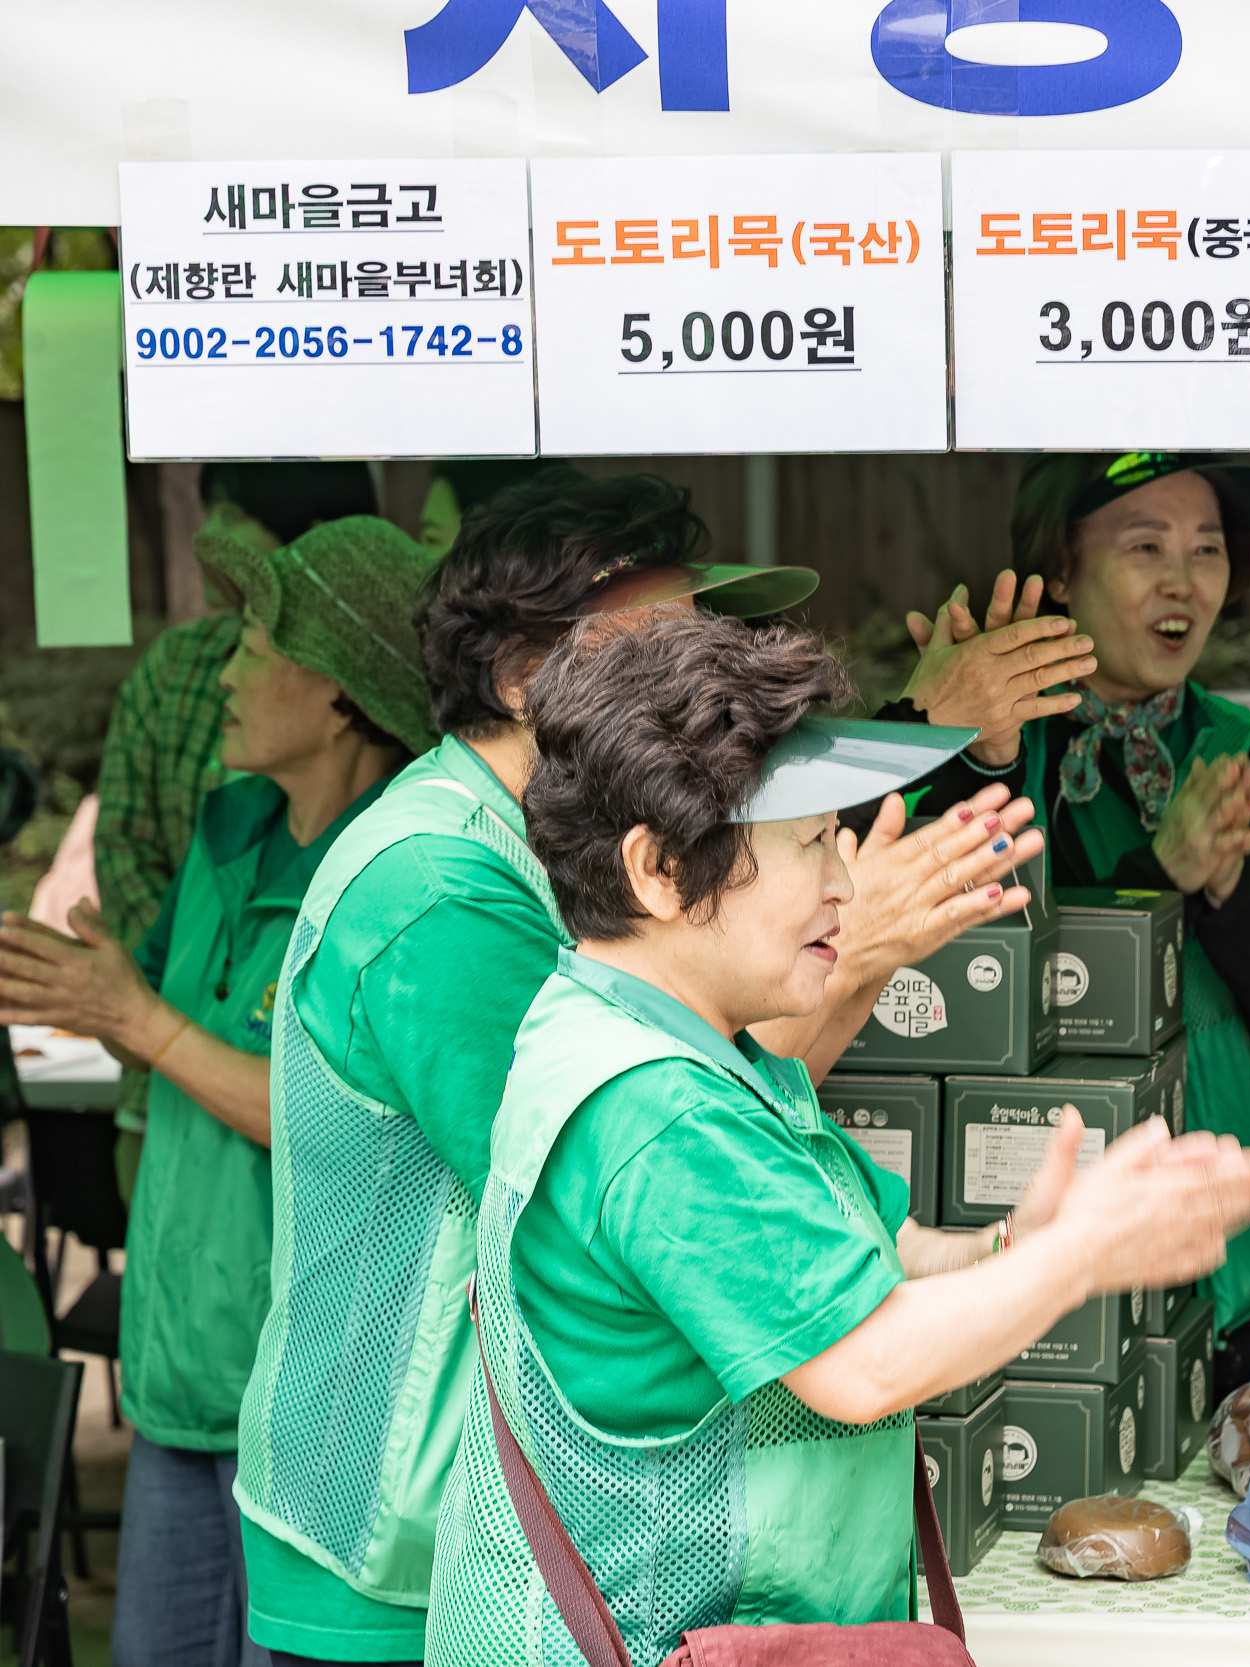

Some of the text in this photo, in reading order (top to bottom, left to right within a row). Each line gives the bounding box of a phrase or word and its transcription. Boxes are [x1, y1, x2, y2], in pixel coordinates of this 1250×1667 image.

[204, 184, 442, 229] 새마을금고
[552, 215, 920, 269] 도토리묵(국산)
[131, 260, 522, 299] (제향란 새마을부녀회)
[137, 325, 522, 359] 9002-2056-1742-8
[621, 307, 856, 369] 5,000원
